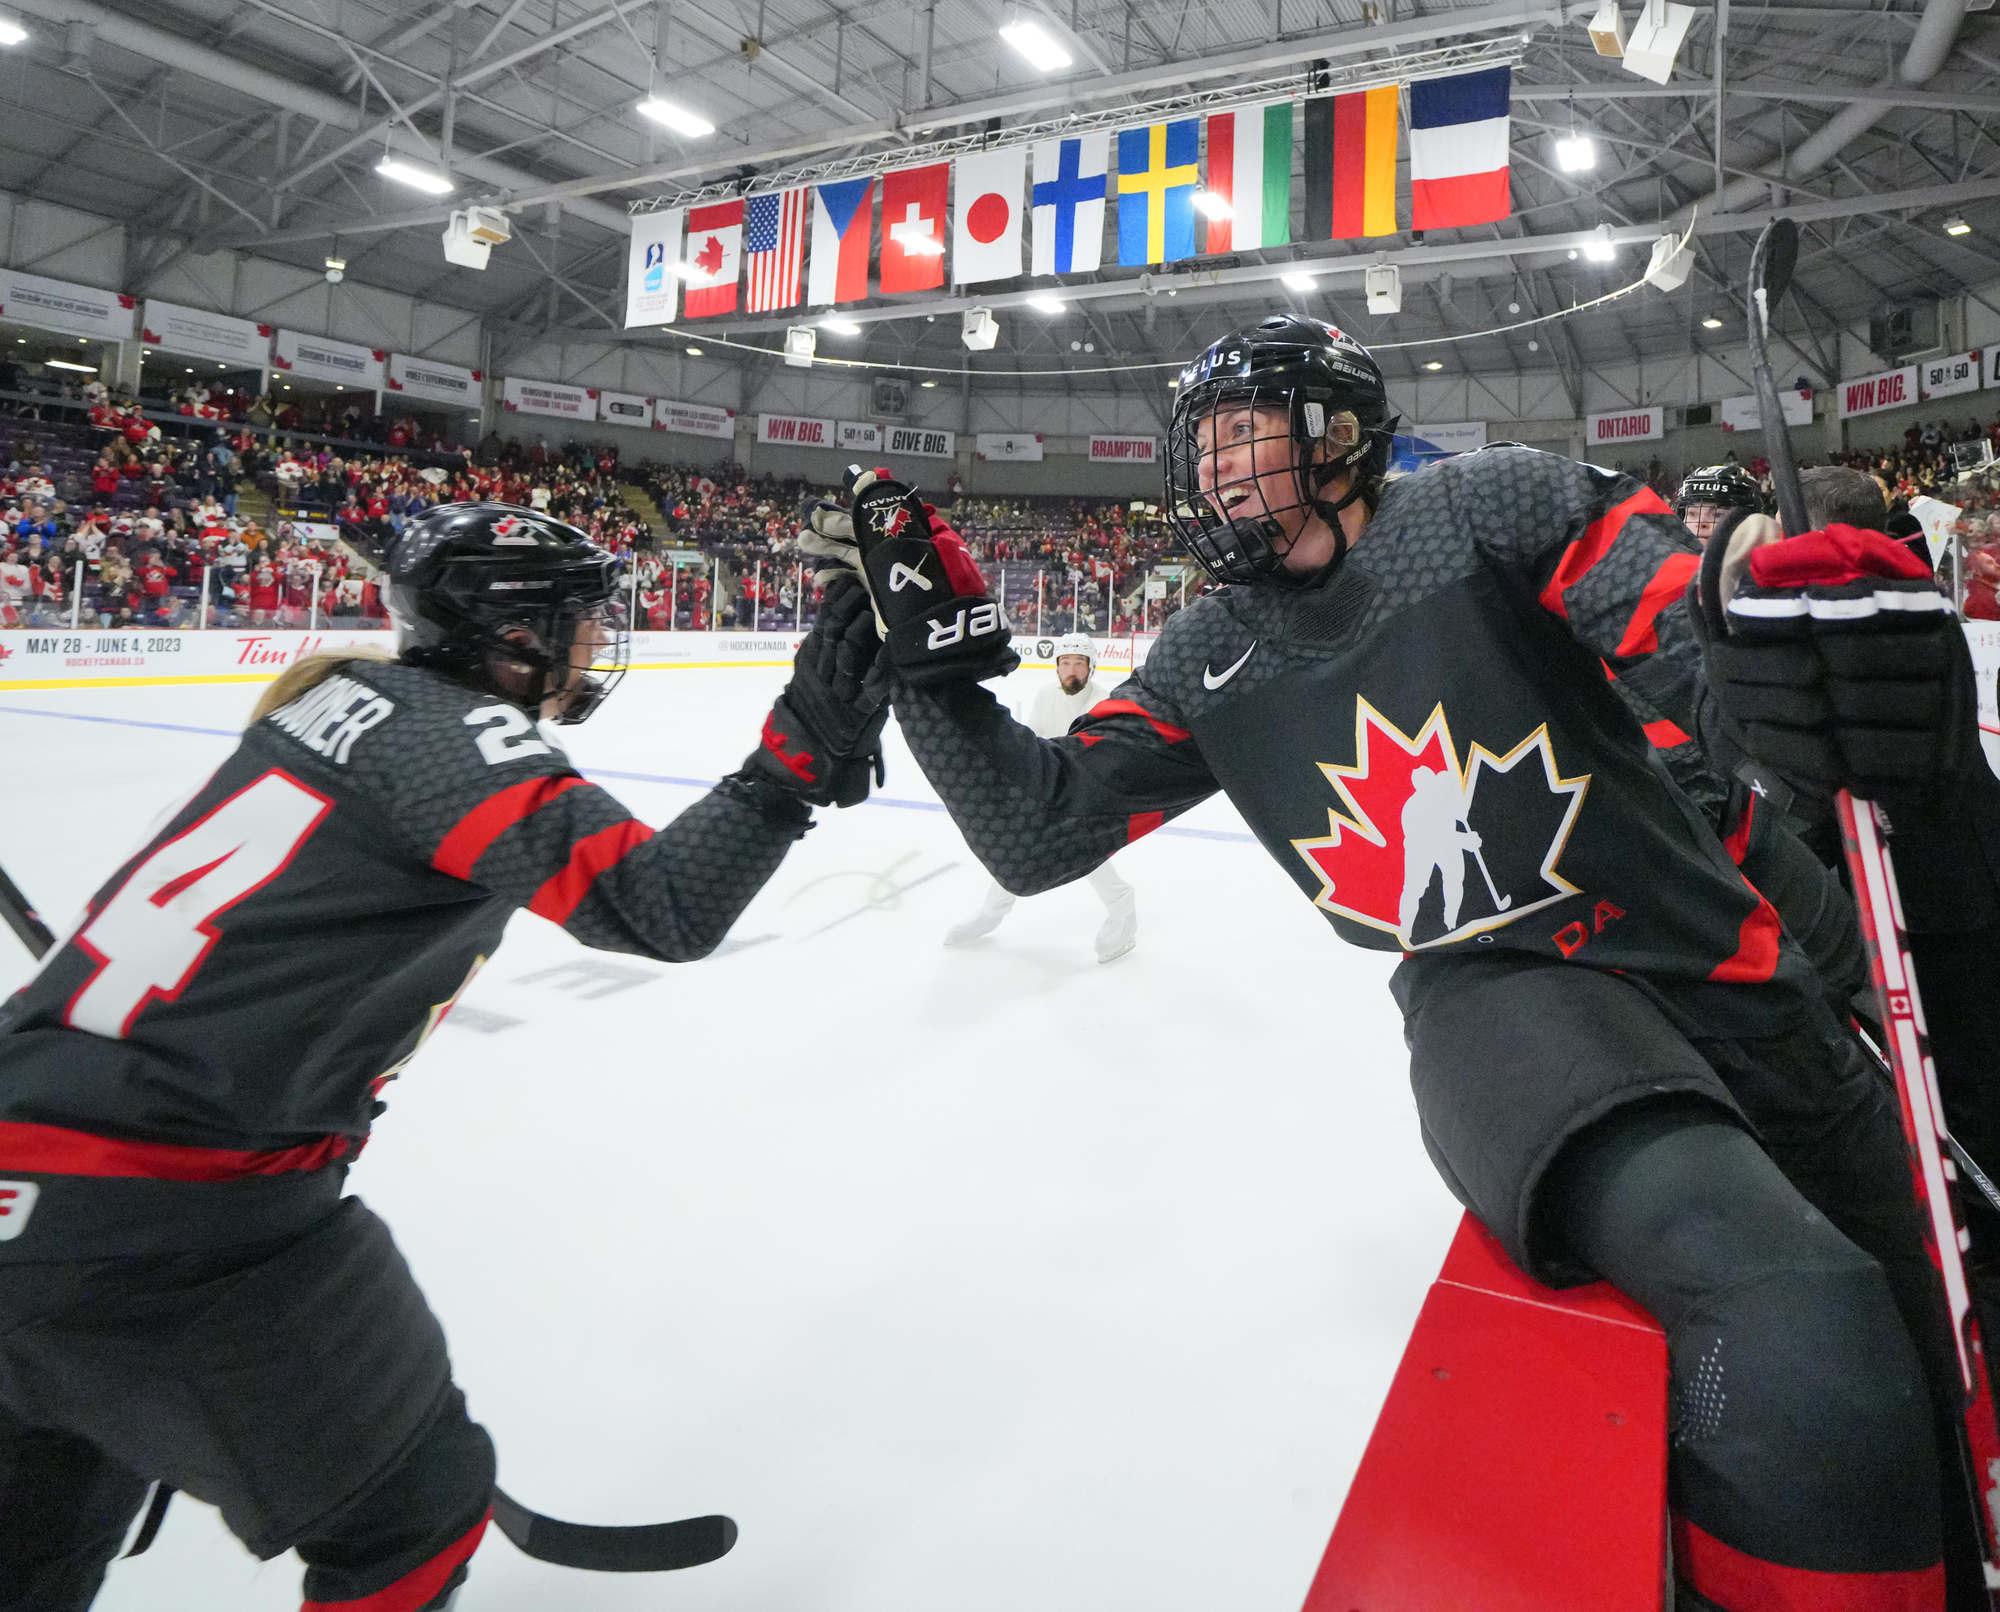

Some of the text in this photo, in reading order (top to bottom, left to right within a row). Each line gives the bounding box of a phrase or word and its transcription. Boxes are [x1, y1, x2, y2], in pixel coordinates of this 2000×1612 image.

[1930, 362, 1969, 385] 50 50
[1846, 374, 1907, 412] WIN BIG.
[767, 418, 825, 443] WIN BIG.
[844, 428, 875, 441] 50 50
[1598, 414, 1650, 439] ONTARIO
[892, 430, 948, 454] GIVE BIG.
[1092, 440, 1153, 458] BRAMPTON
[1692, 482, 1729, 492] TELUS
[26, 638, 59, 654] MAY
[63, 638, 82, 654] 28
[95, 638, 128, 653] JUNE
[147, 637, 182, 653] 2023
[236, 637, 288, 665] Tim
[730, 640, 788, 651] HOCKEYCANADA
